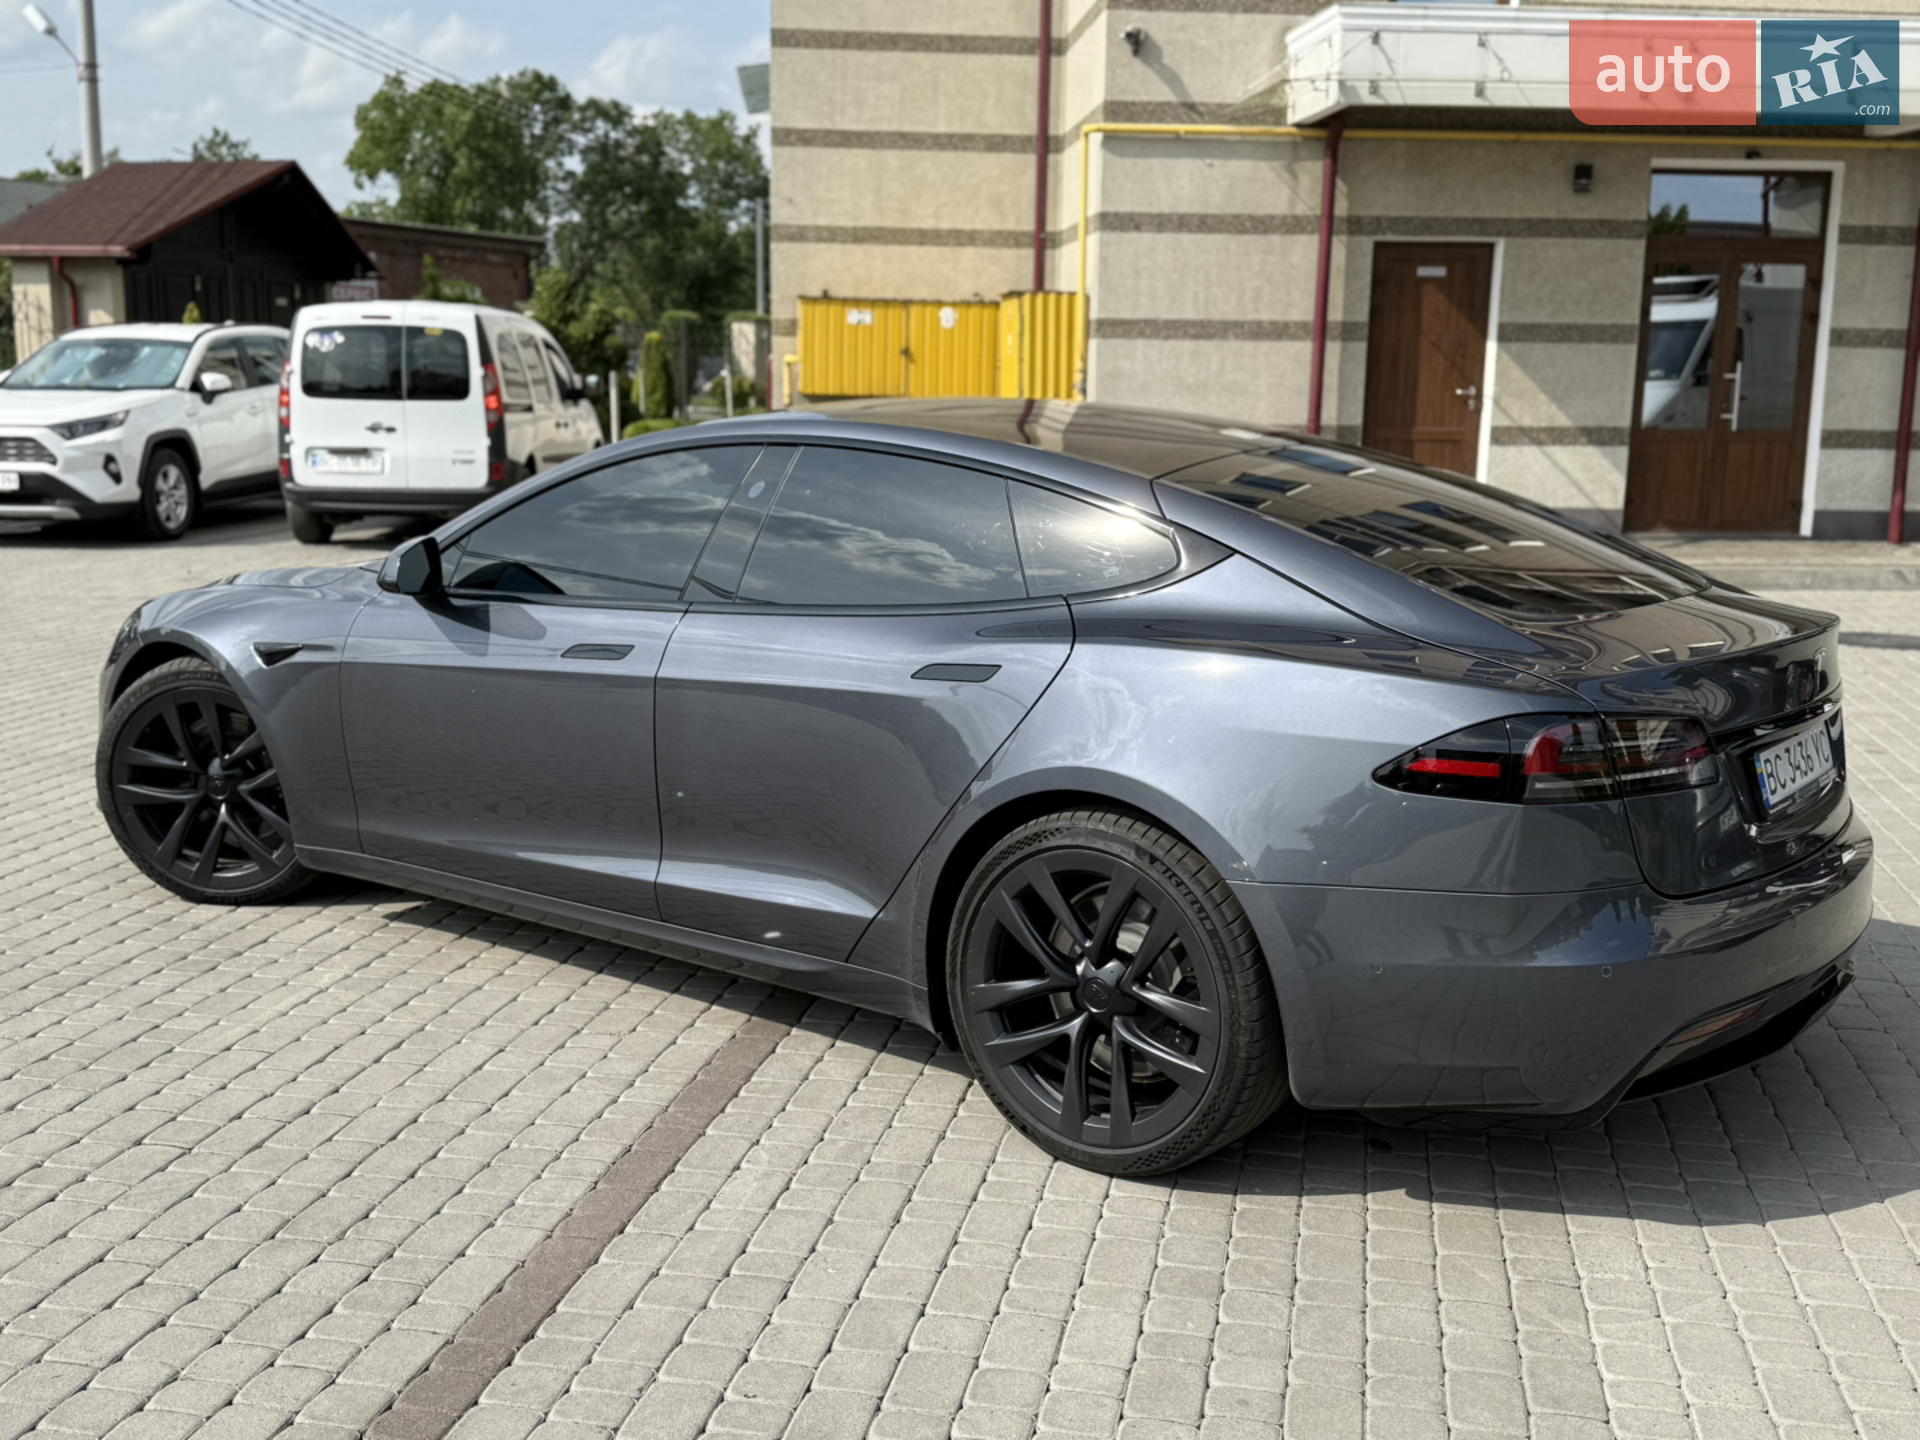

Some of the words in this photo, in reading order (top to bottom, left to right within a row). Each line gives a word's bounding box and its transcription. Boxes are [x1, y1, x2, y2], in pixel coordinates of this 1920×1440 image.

[1763, 753, 1787, 796] BC
[1784, 738, 1814, 784] 3436
[1810, 729, 1830, 768] YC
[1151, 858, 1214, 931] MICHELIN
